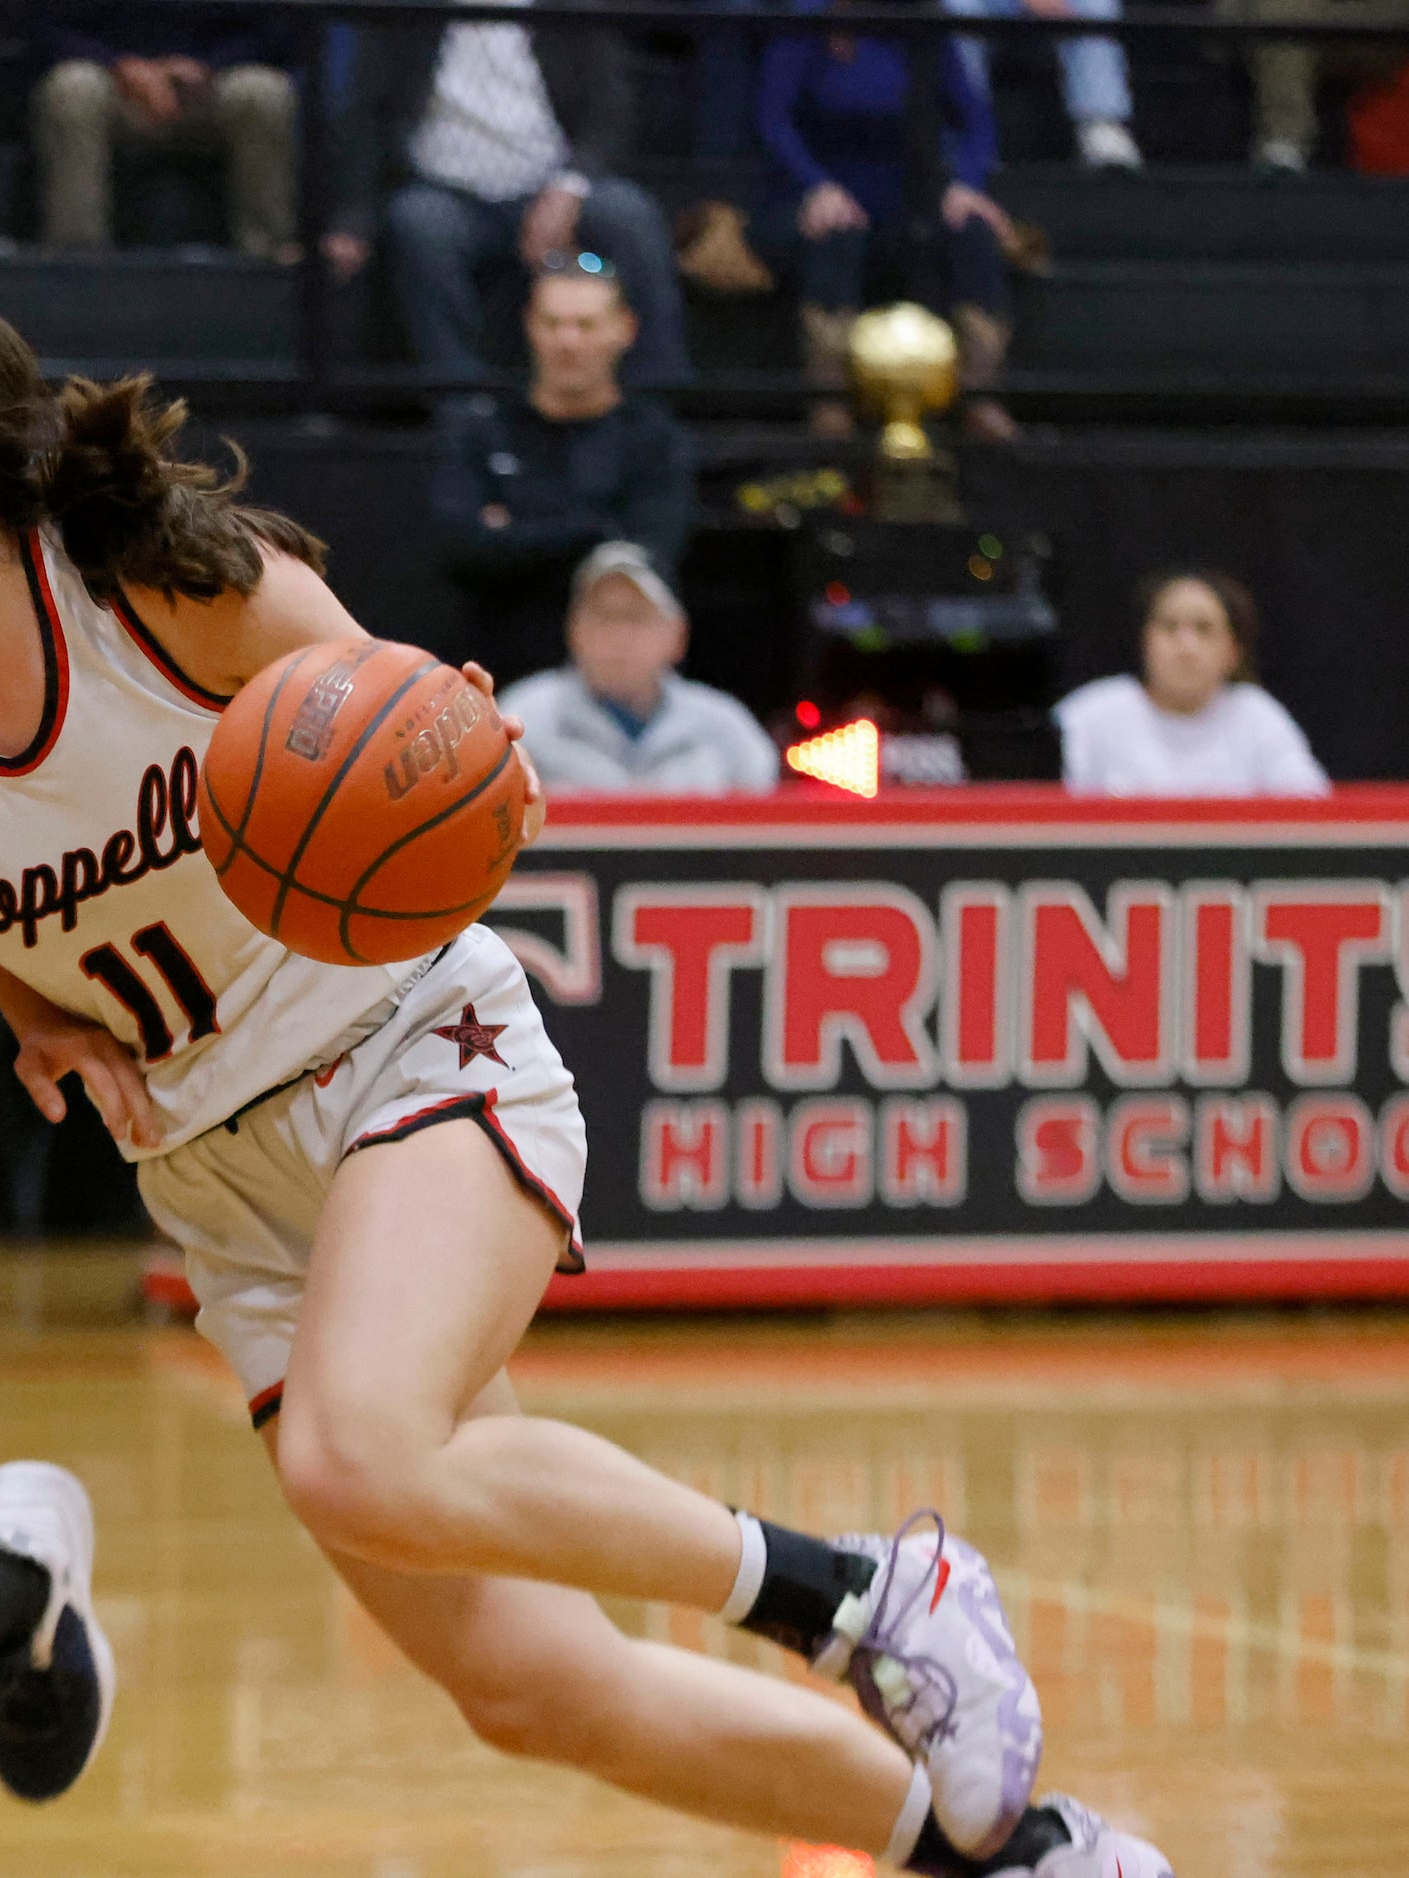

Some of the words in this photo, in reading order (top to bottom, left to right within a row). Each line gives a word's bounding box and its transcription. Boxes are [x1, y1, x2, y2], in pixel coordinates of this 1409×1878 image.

[78, 919, 222, 1065] 11
[612, 880, 1409, 1093] TRINIT
[639, 1094, 967, 1212] HIGH
